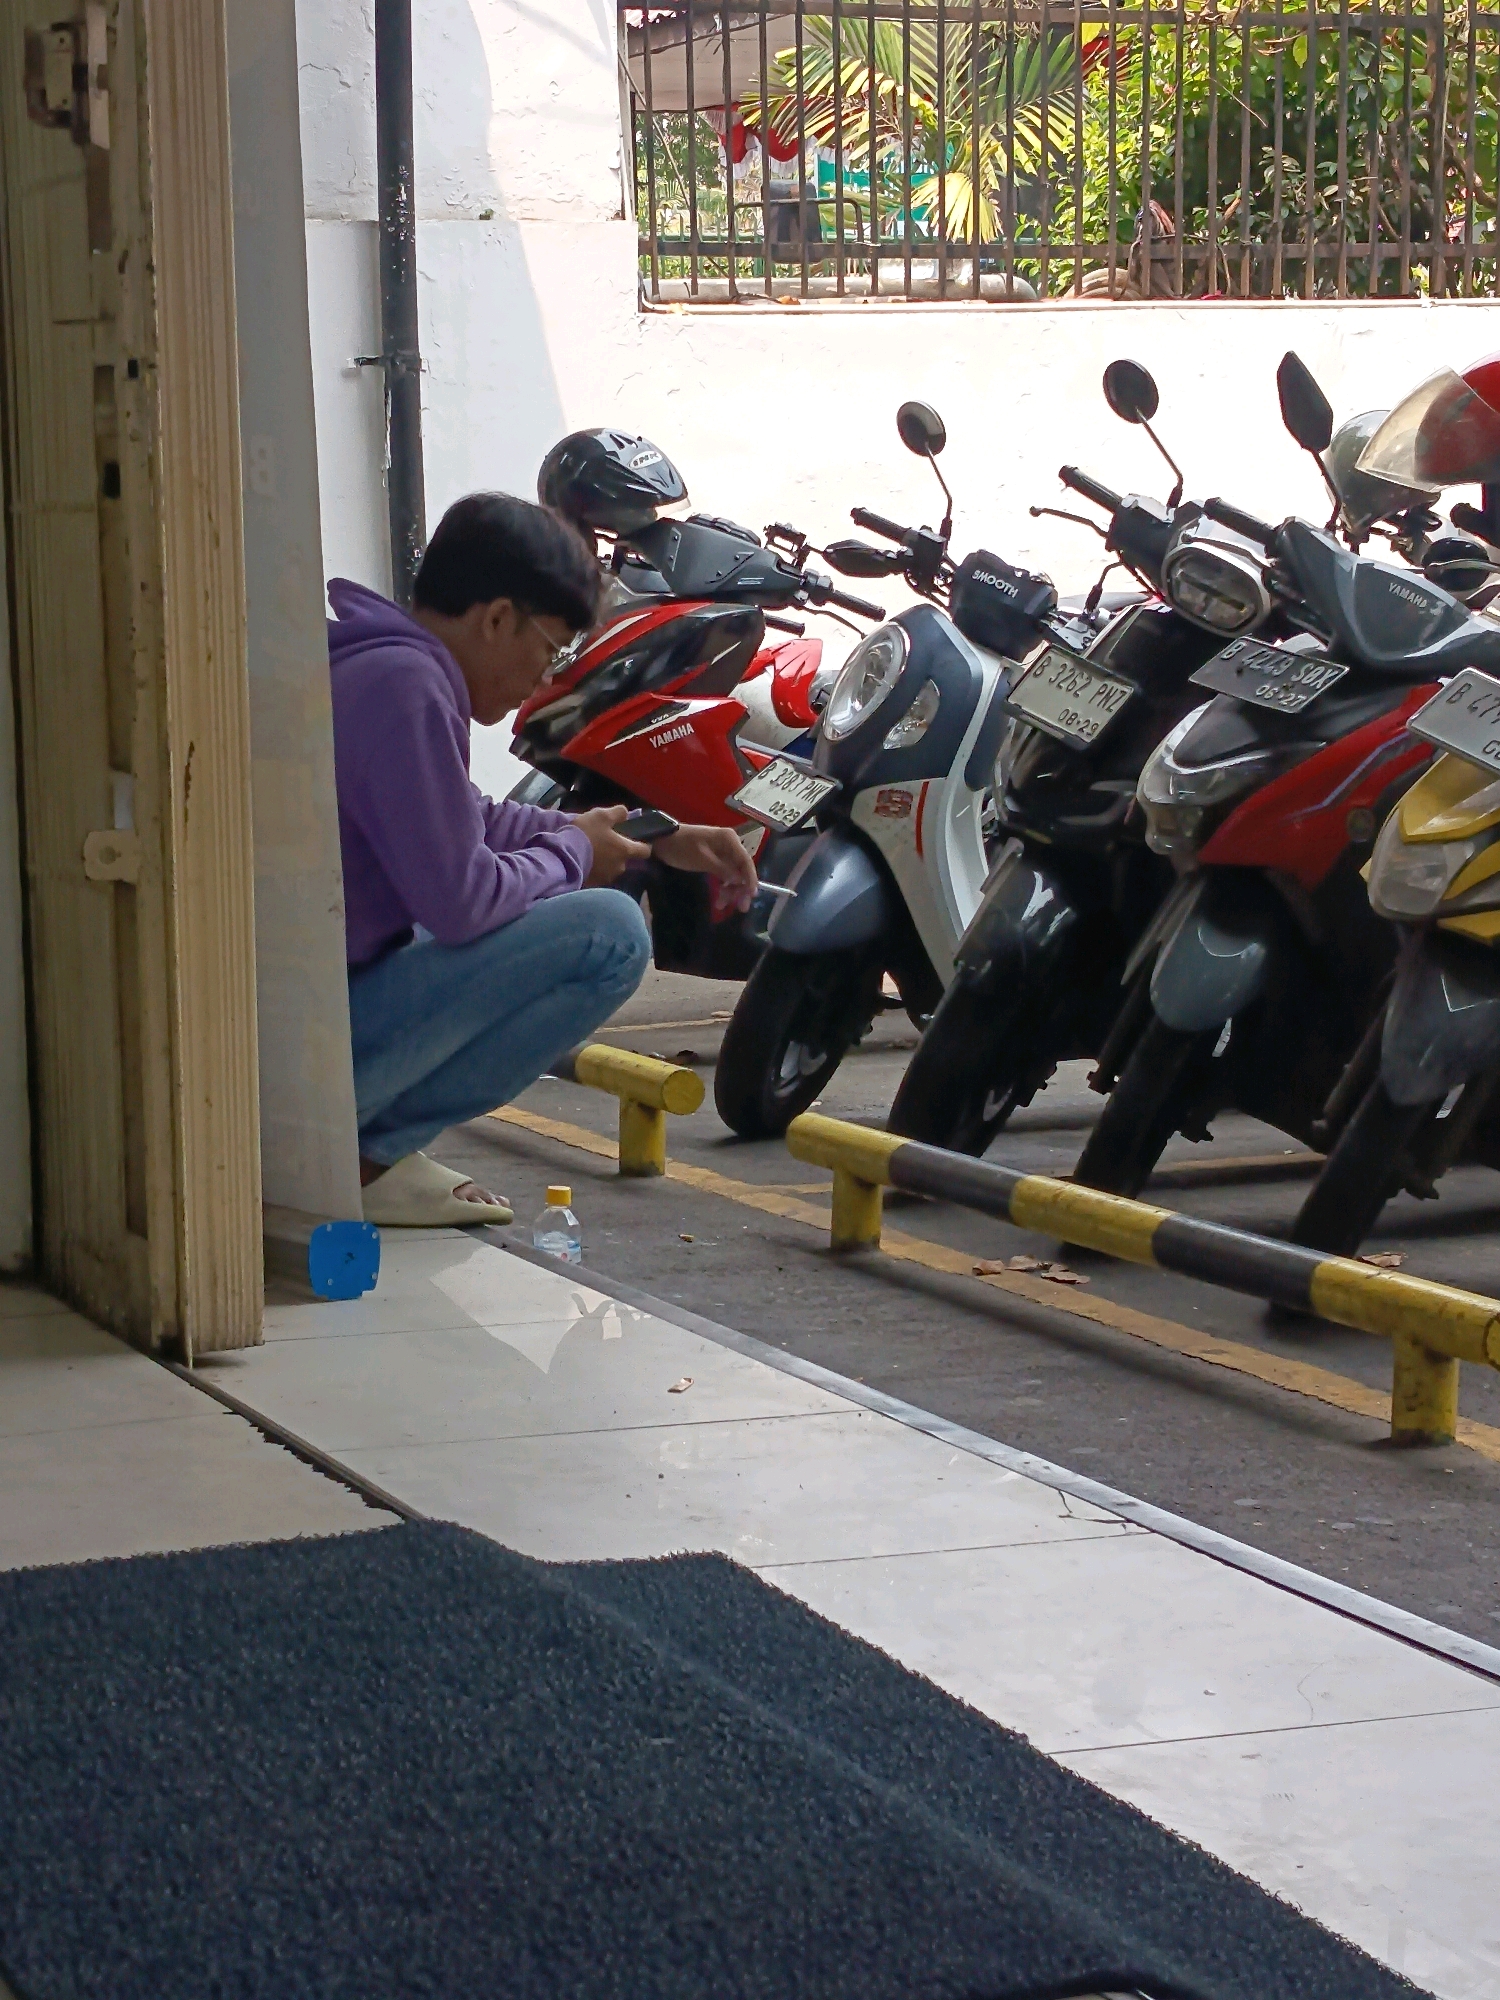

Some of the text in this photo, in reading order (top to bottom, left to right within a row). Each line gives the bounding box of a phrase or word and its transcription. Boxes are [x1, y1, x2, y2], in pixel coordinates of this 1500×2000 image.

[971, 569, 1019, 598] SMOOTH
[1388, 582, 1428, 608] YAMAHA
[1220, 641, 1247, 660] B
[1033, 655, 1128, 713] B 3262 PNZ
[1446, 682, 1473, 704] B
[649, 723, 695, 749] YAMAHA
[757, 762, 778, 780] B
